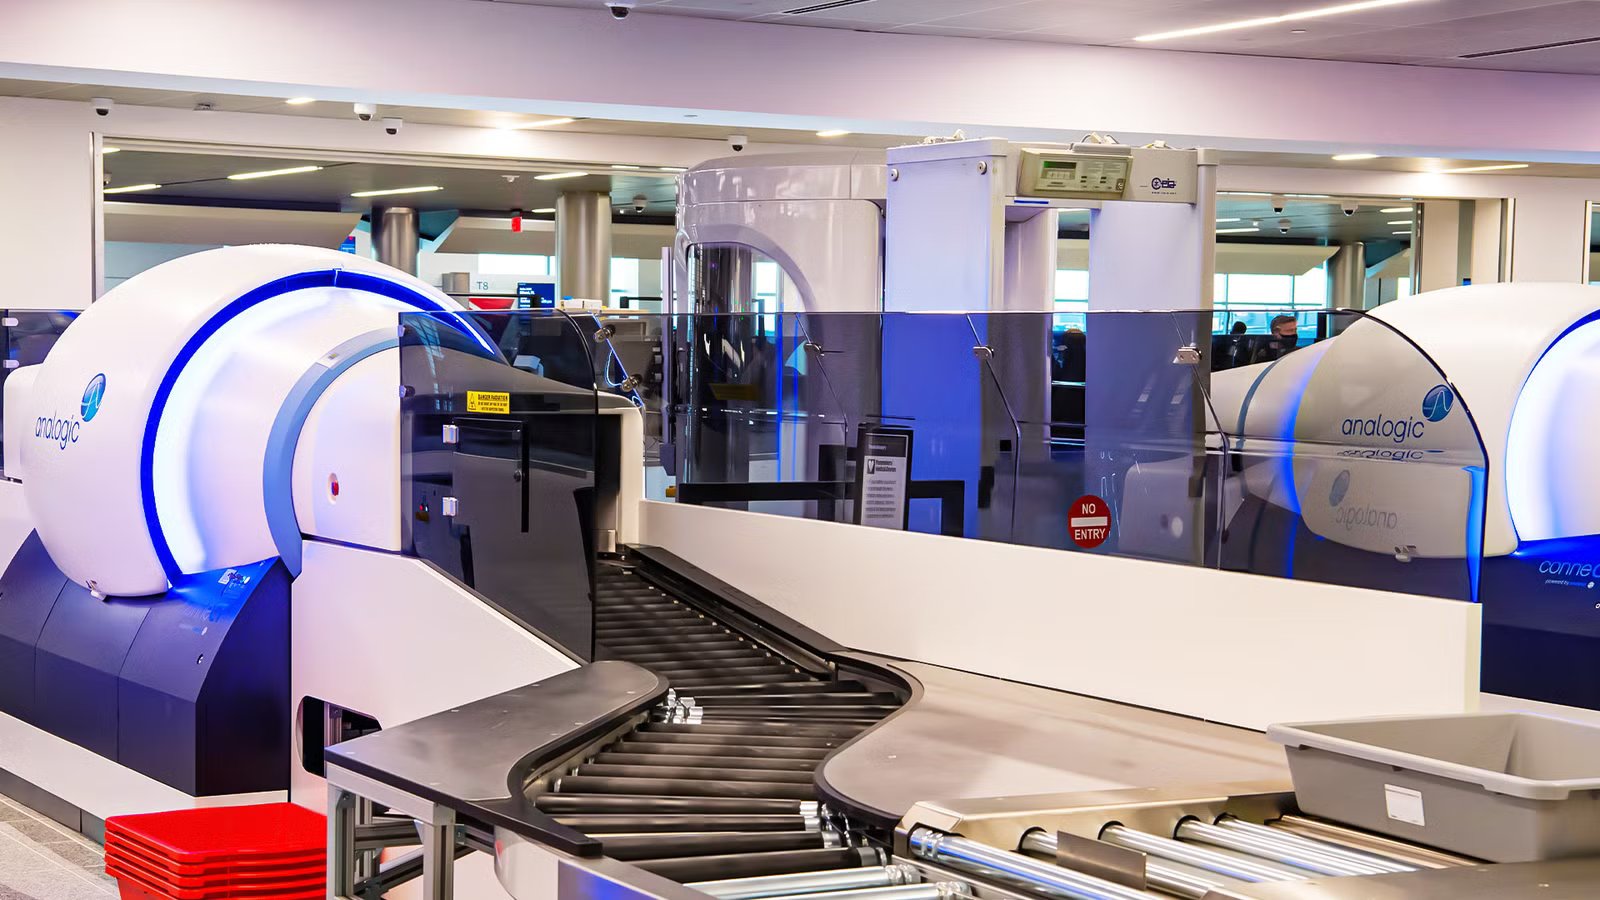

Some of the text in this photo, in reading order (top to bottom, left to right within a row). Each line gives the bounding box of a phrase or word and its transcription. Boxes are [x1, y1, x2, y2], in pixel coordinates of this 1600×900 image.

[477, 281, 489, 290] T8
[36, 409, 80, 450] analogic
[1341, 413, 1425, 443] analogic
[1081, 503, 1096, 514] NO
[1074, 528, 1106, 540] ENTRY
